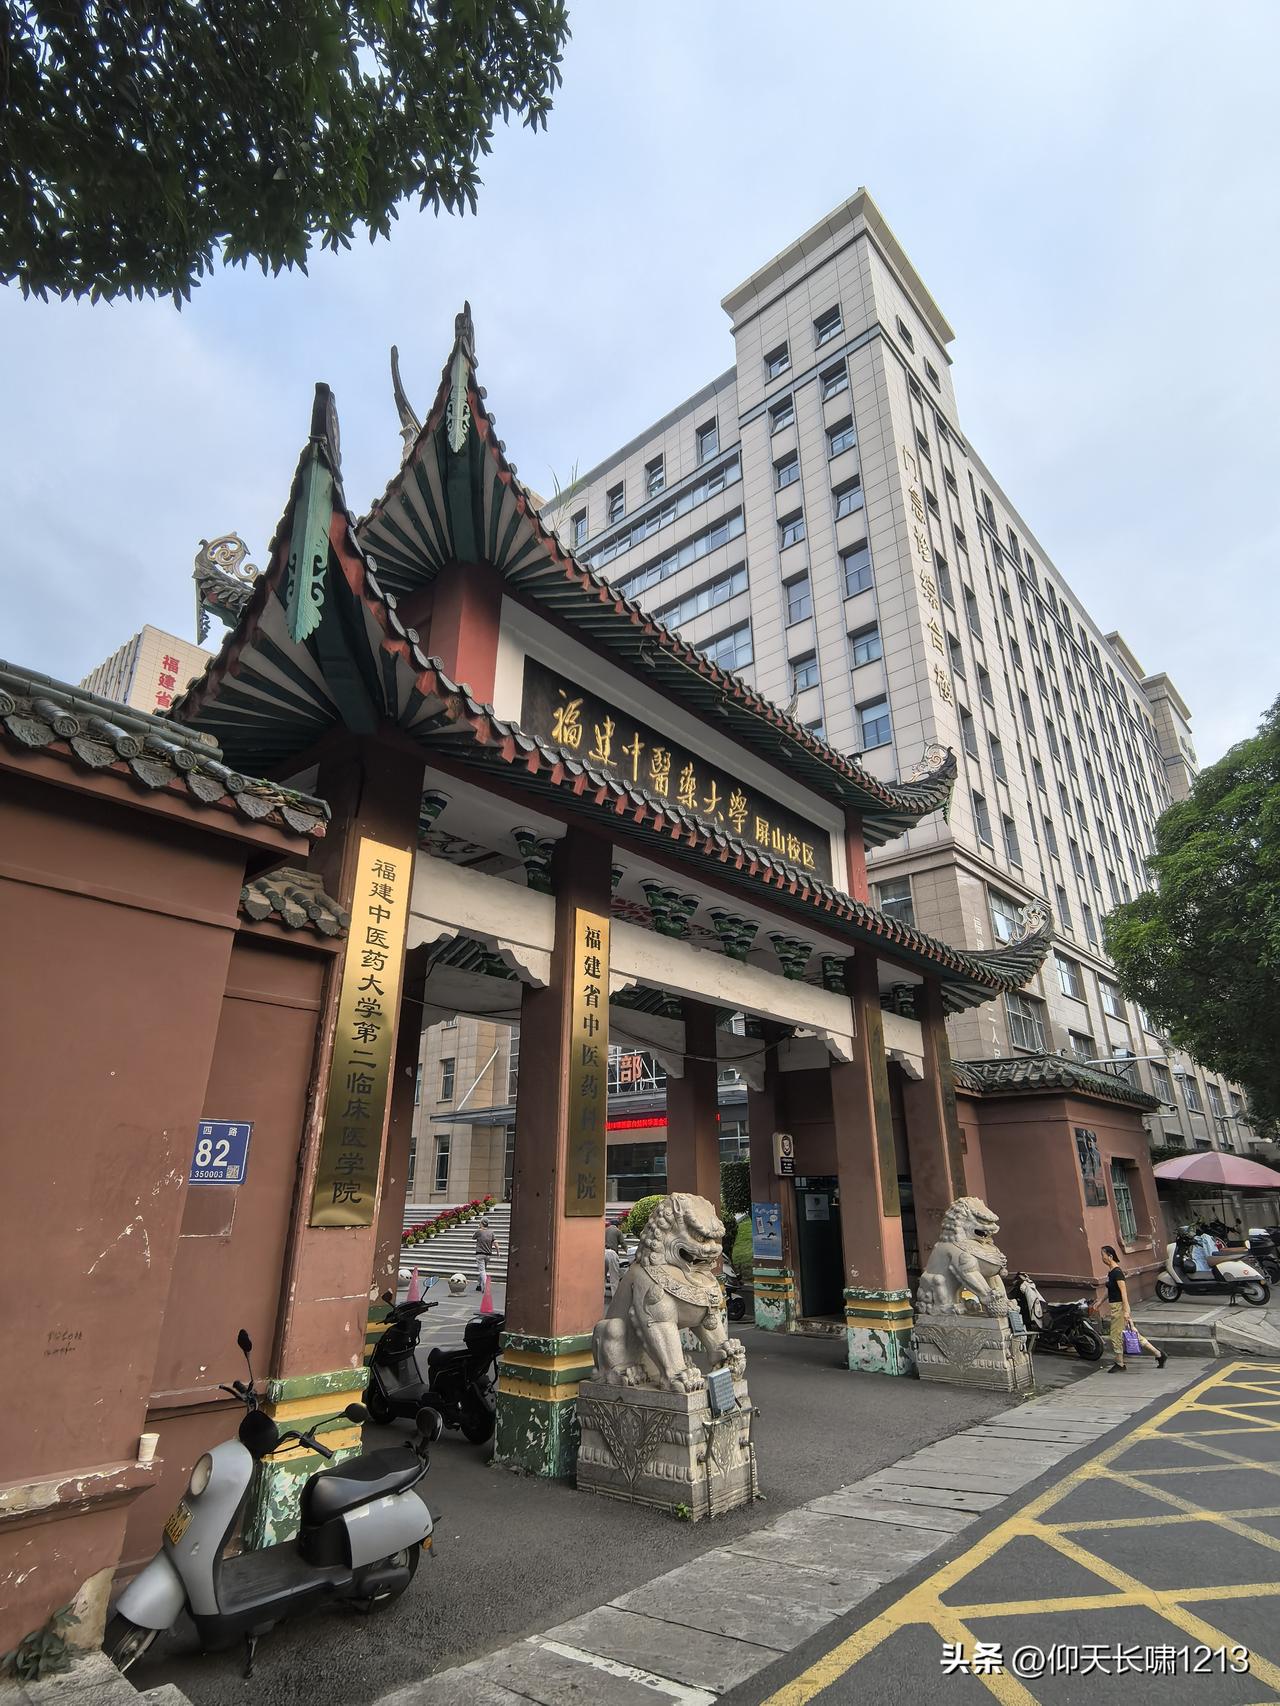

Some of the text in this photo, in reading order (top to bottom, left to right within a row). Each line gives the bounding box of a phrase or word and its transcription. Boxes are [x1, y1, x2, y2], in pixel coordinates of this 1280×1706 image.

[155, 655, 180, 708] 福建省
[755, 816, 816, 869] 屏山校区
[332, 858, 397, 1206] 福建中医药大学第二临床医学院
[576, 926, 602, 1200] 福建省中医药科学院
[620, 1055, 642, 1084] 部
[194, 1170, 224, 1178] 350003
[195, 1138, 230, 1167] 82
